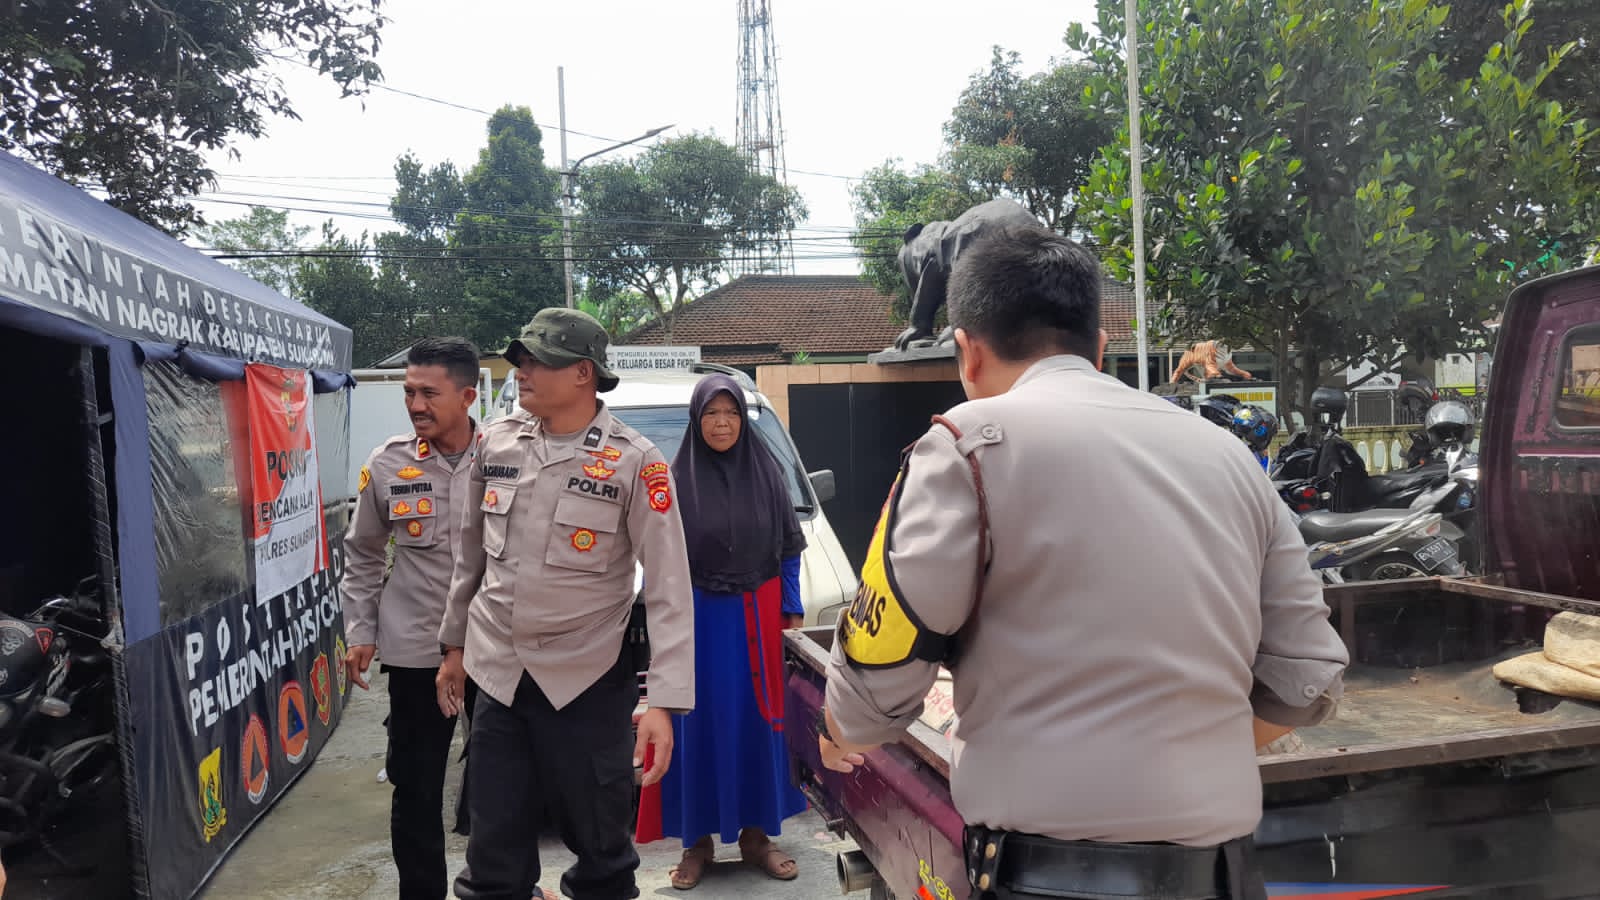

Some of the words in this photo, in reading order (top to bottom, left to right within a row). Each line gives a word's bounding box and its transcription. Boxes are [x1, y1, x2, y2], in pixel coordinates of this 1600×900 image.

[116, 295, 205, 345] NAGRAK
[203, 290, 259, 329] DESA
[617, 358, 653, 369] KELUARGA
[654, 358, 676, 369] BESAR
[567, 476, 620, 500] POLRI
